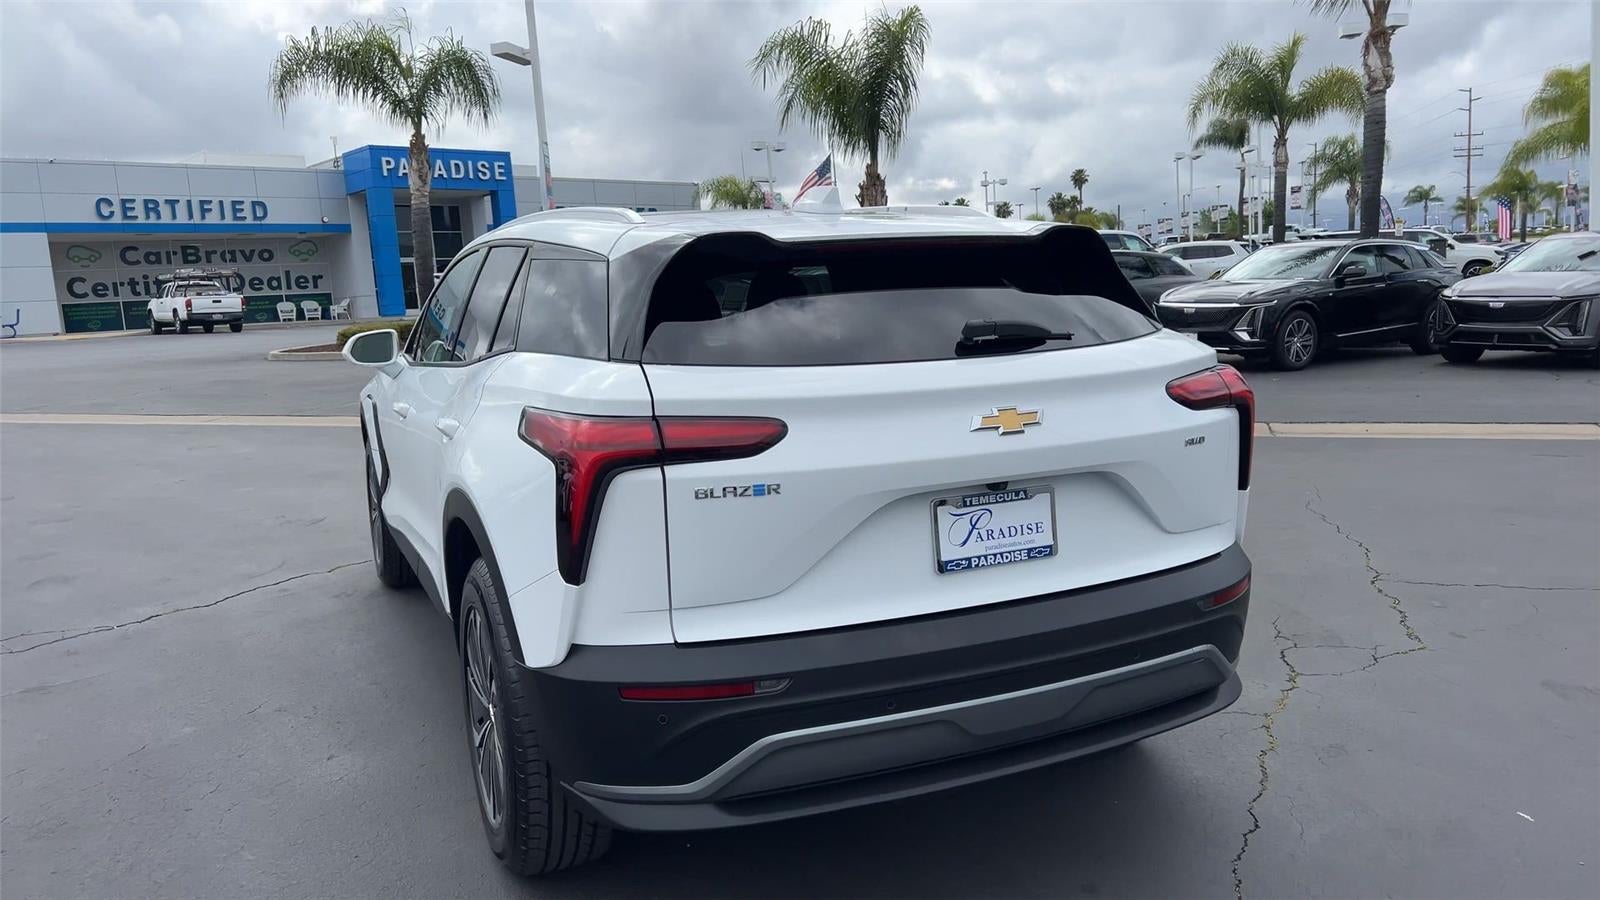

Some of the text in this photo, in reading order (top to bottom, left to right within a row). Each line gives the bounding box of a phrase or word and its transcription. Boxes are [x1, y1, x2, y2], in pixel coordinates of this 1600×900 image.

[381, 156, 507, 180] PAADISE
[95, 196, 269, 222] CERTIFIED
[119, 245, 274, 266] CarBravo
[66, 270, 324, 299] Certif Dealer
[694, 483, 782, 500] BLAZER
[964, 490, 1026, 506] TEMECULA
[948, 508, 1045, 548] PARADISE
[971, 549, 1029, 568] PARADISE
